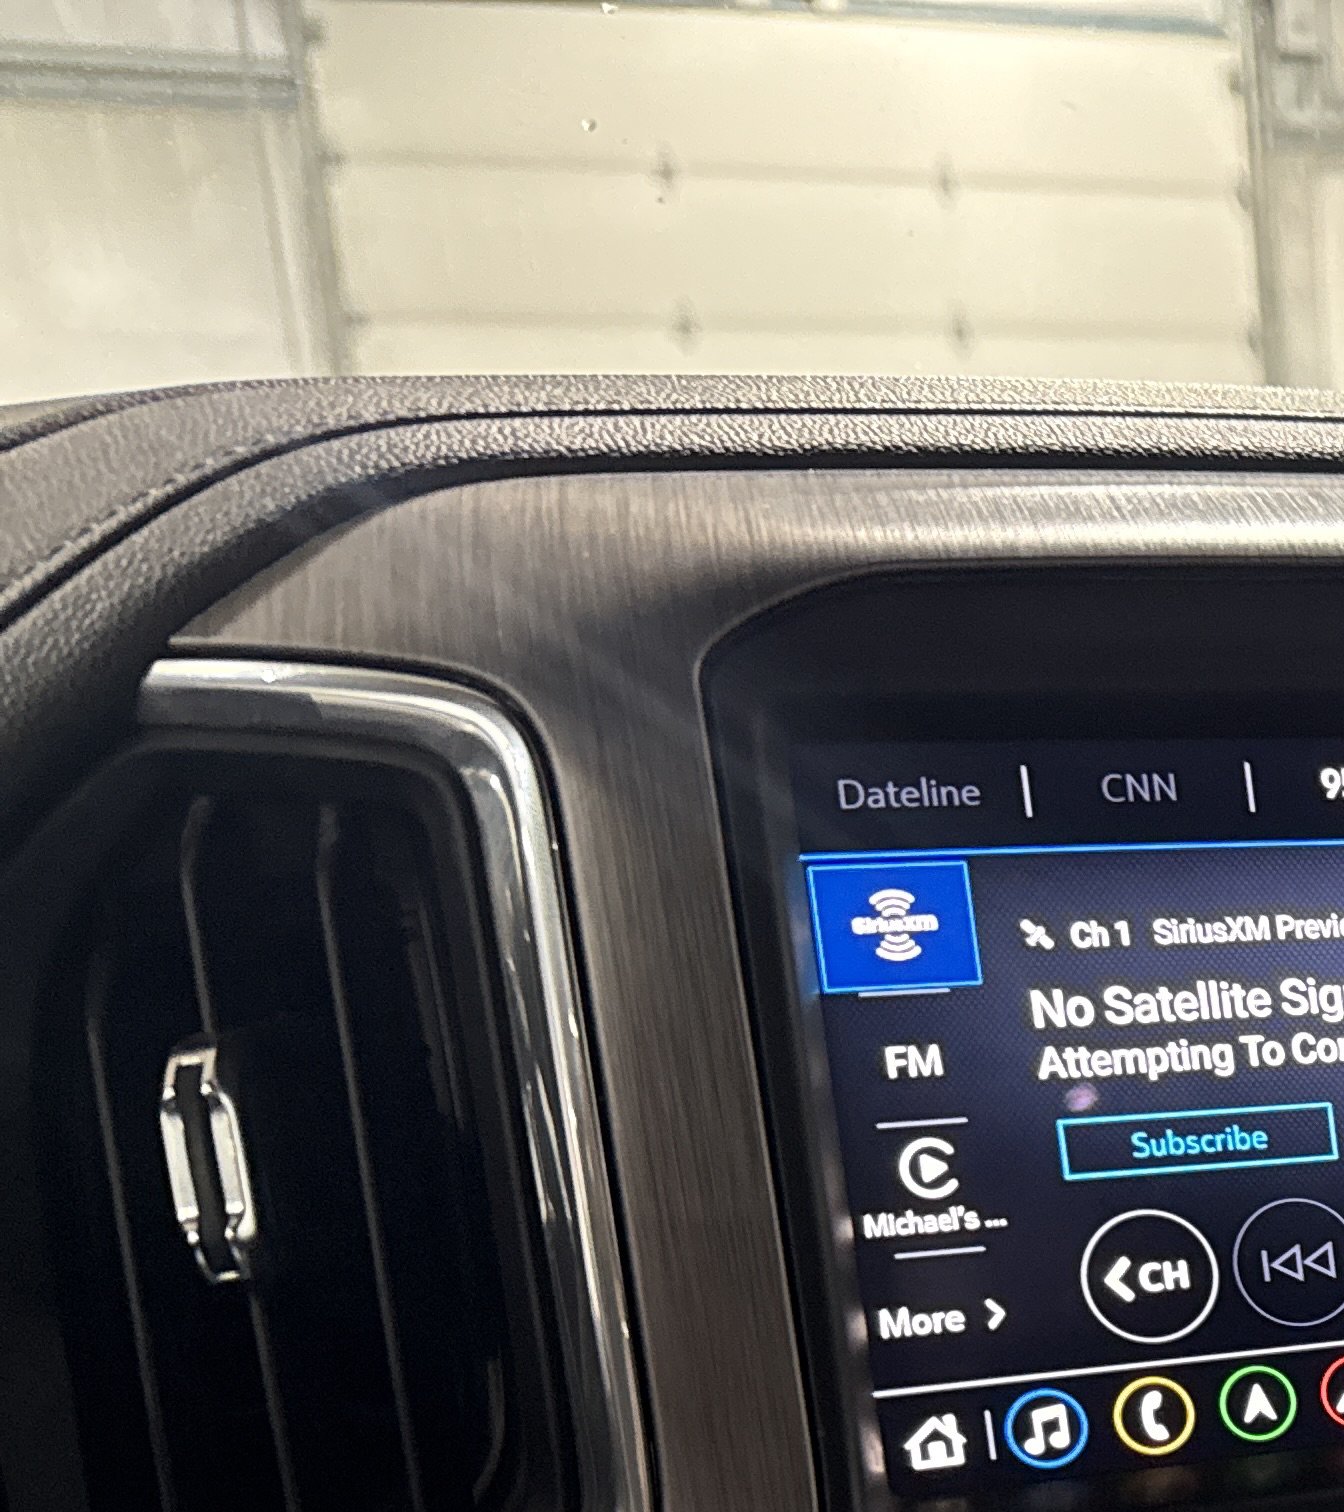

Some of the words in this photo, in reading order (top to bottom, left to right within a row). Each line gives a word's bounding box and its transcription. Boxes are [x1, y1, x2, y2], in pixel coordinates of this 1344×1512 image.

[837, 776, 981, 810] Dateline
[1101, 773, 1178, 803] CNN
[1069, 919, 1110, 949] Ch
[1113, 920, 1131, 947] 1
[1152, 914, 1272, 946] SiriusXM
[1029, 988, 1095, 1029] No
[1103, 979, 1273, 1025] Satellite
[884, 1043, 944, 1080] FM
[1038, 1040, 1235, 1080] Attempting
[1246, 1035, 1286, 1067] To
[1131, 1125, 1269, 1160] Subscribe
[862, 1204, 981, 1239] Michael's
[1138, 1259, 1190, 1292] CH
[877, 1306, 966, 1340] More
